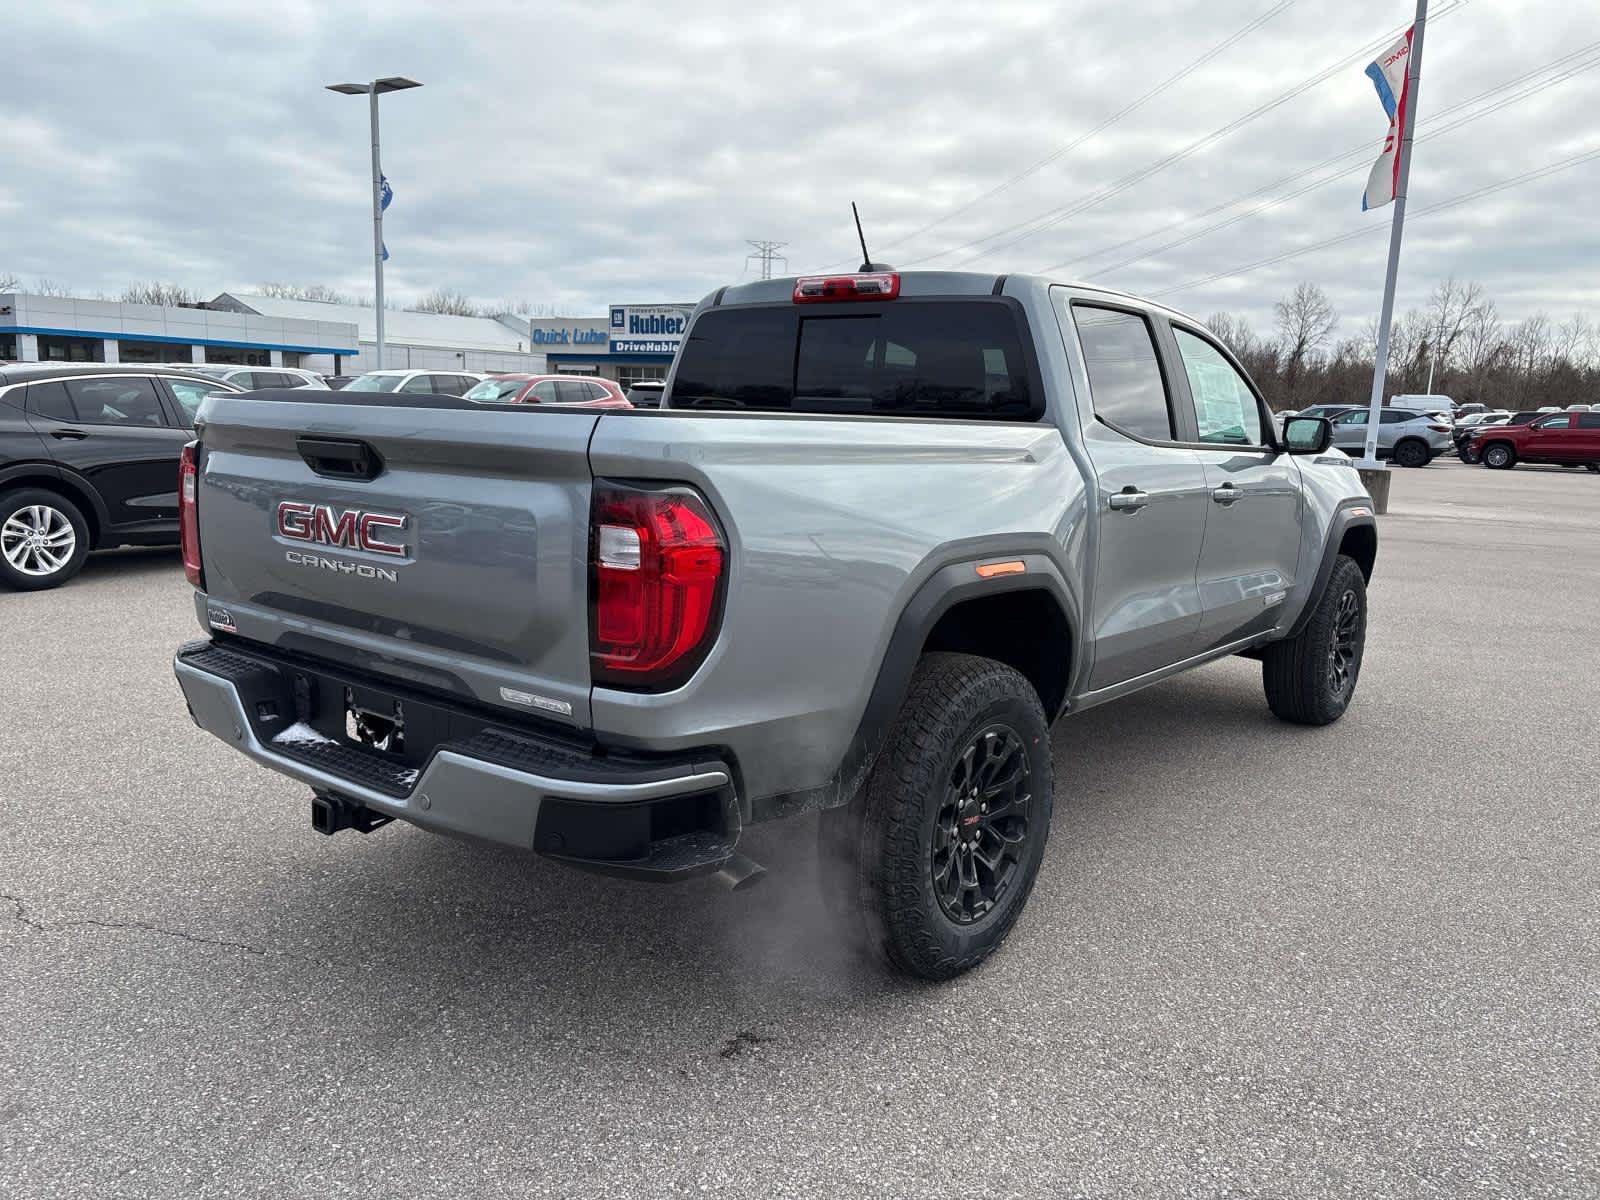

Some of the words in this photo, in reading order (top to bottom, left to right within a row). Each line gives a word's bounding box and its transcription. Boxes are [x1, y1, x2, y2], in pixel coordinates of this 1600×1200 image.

[534, 328, 568, 344] Quick
[573, 328, 607, 344] Lube
[629, 315, 684, 334] Hubler
[278, 501, 408, 558] GMC
[286, 551, 398, 583] CANYON
